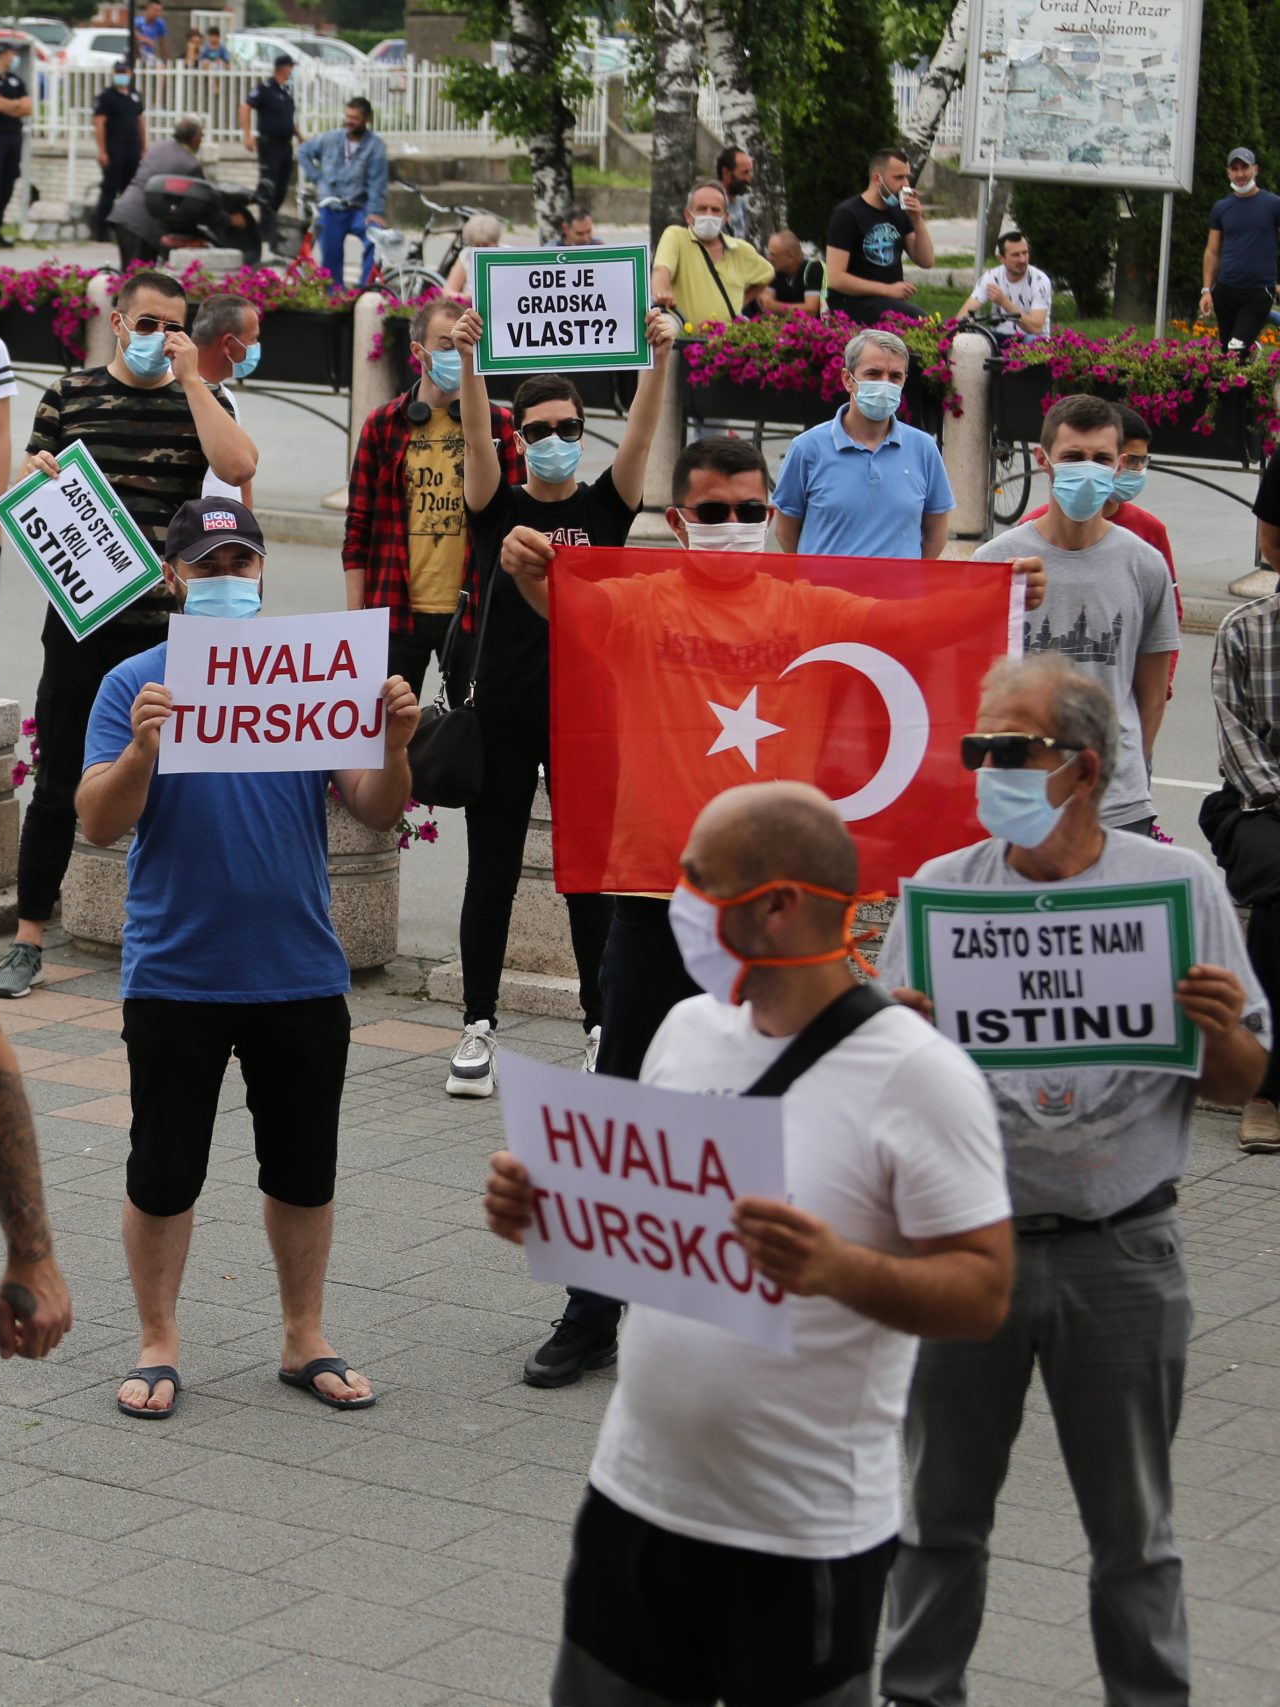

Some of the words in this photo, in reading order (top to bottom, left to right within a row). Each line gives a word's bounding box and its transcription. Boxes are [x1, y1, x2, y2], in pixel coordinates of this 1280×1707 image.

[1040, 0, 1078, 12] Grad
[1084, 0, 1121, 15] Novi
[1127, 2, 1171, 17] Pazar
[528, 270, 567, 289] GDE
[571, 269, 594, 288] JE
[517, 294, 607, 314] GRADSKA
[506, 318, 618, 348] VLAST??
[415, 467, 443, 488] No
[60, 478, 97, 521] ZAŠTO
[88, 518, 114, 547] STE
[103, 541, 133, 574] NAM
[204, 511, 235, 521] LIQUI
[205, 519, 235, 529] MOLY
[19, 506, 94, 604] ISTINU
[59, 523, 92, 560] KRILI
[206, 639, 358, 686] HVALA
[170, 697, 384, 744] TURSKOJ
[951, 920, 1029, 959] ZAŠTO
[1038, 925, 1084, 956] STE
[1090, 921, 1144, 954] NAM
[1019, 969, 1084, 1000] KRILI
[956, 1003, 1154, 1044] ISTINU
[541, 1104, 736, 1202] HVALA
